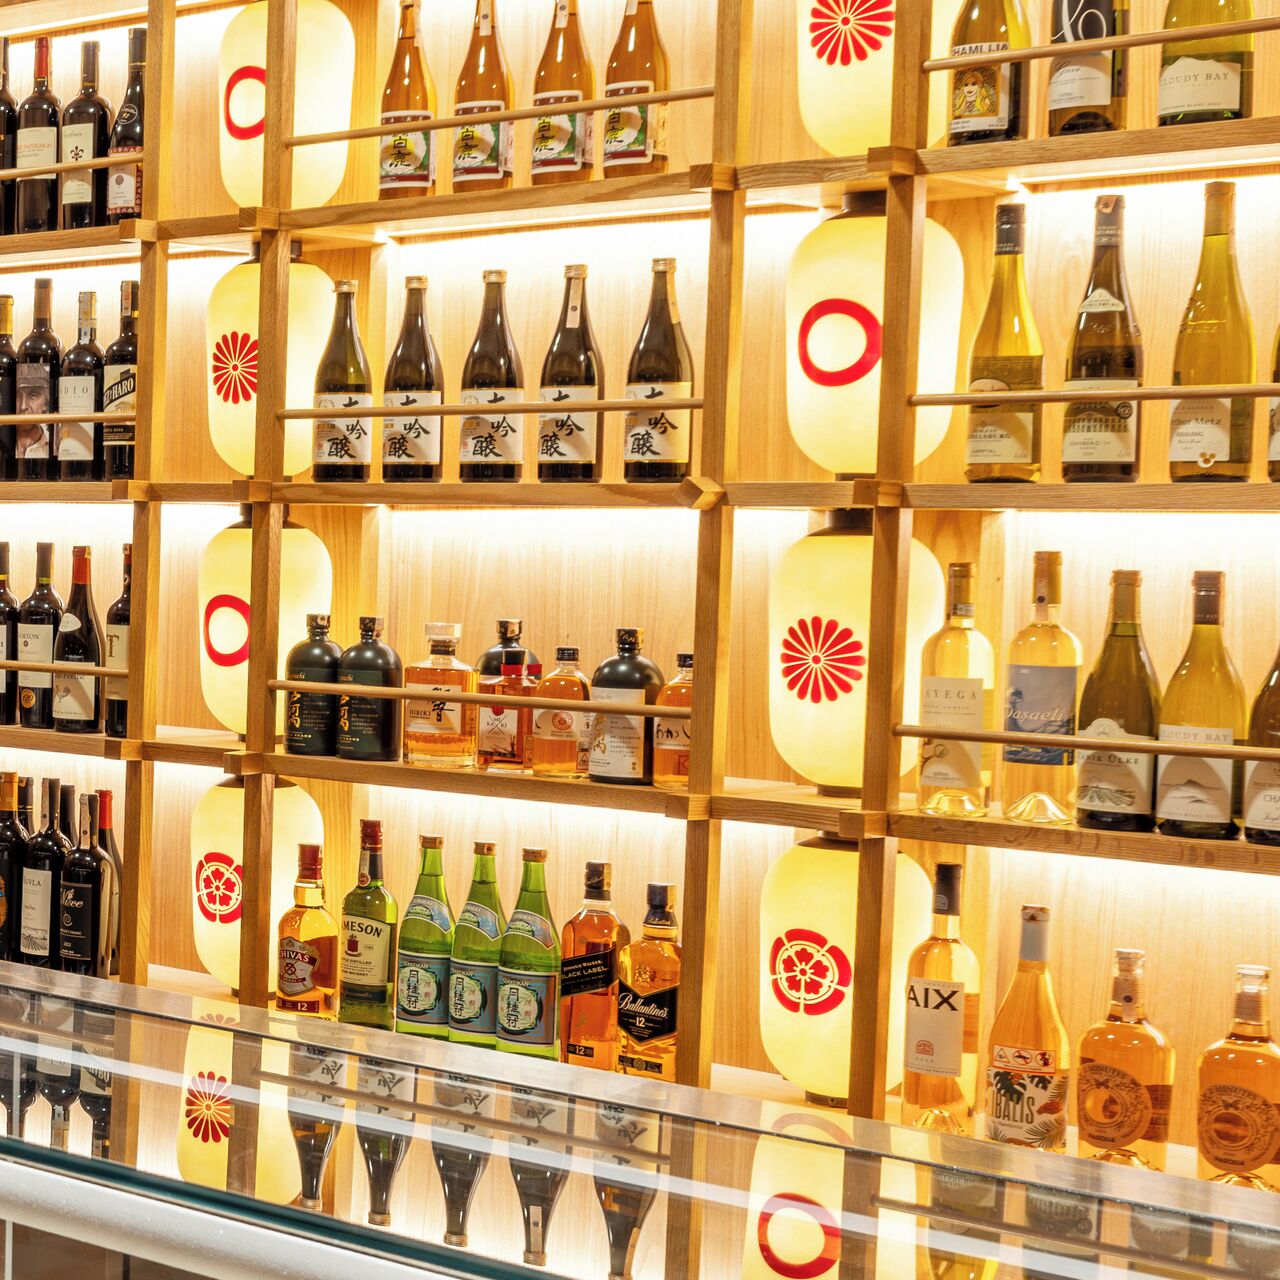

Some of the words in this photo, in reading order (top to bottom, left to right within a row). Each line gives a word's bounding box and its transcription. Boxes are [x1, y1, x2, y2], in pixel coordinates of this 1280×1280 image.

[1205, 72, 1229, 81] BAY
[112, 376, 135, 398] HARO
[409, 709, 431, 717] HIBIKI
[1205, 732, 1230, 743] BAY
[280, 950, 310, 963] HIVAS
[582, 965, 608, 976] LABEL
[908, 984, 960, 1012] AIX
[297, 1002, 308, 1011] 12
[619, 991, 669, 1019] Ballantine's
[635, 1016, 646, 1028] 12
[575, 1045, 586, 1056] 12
